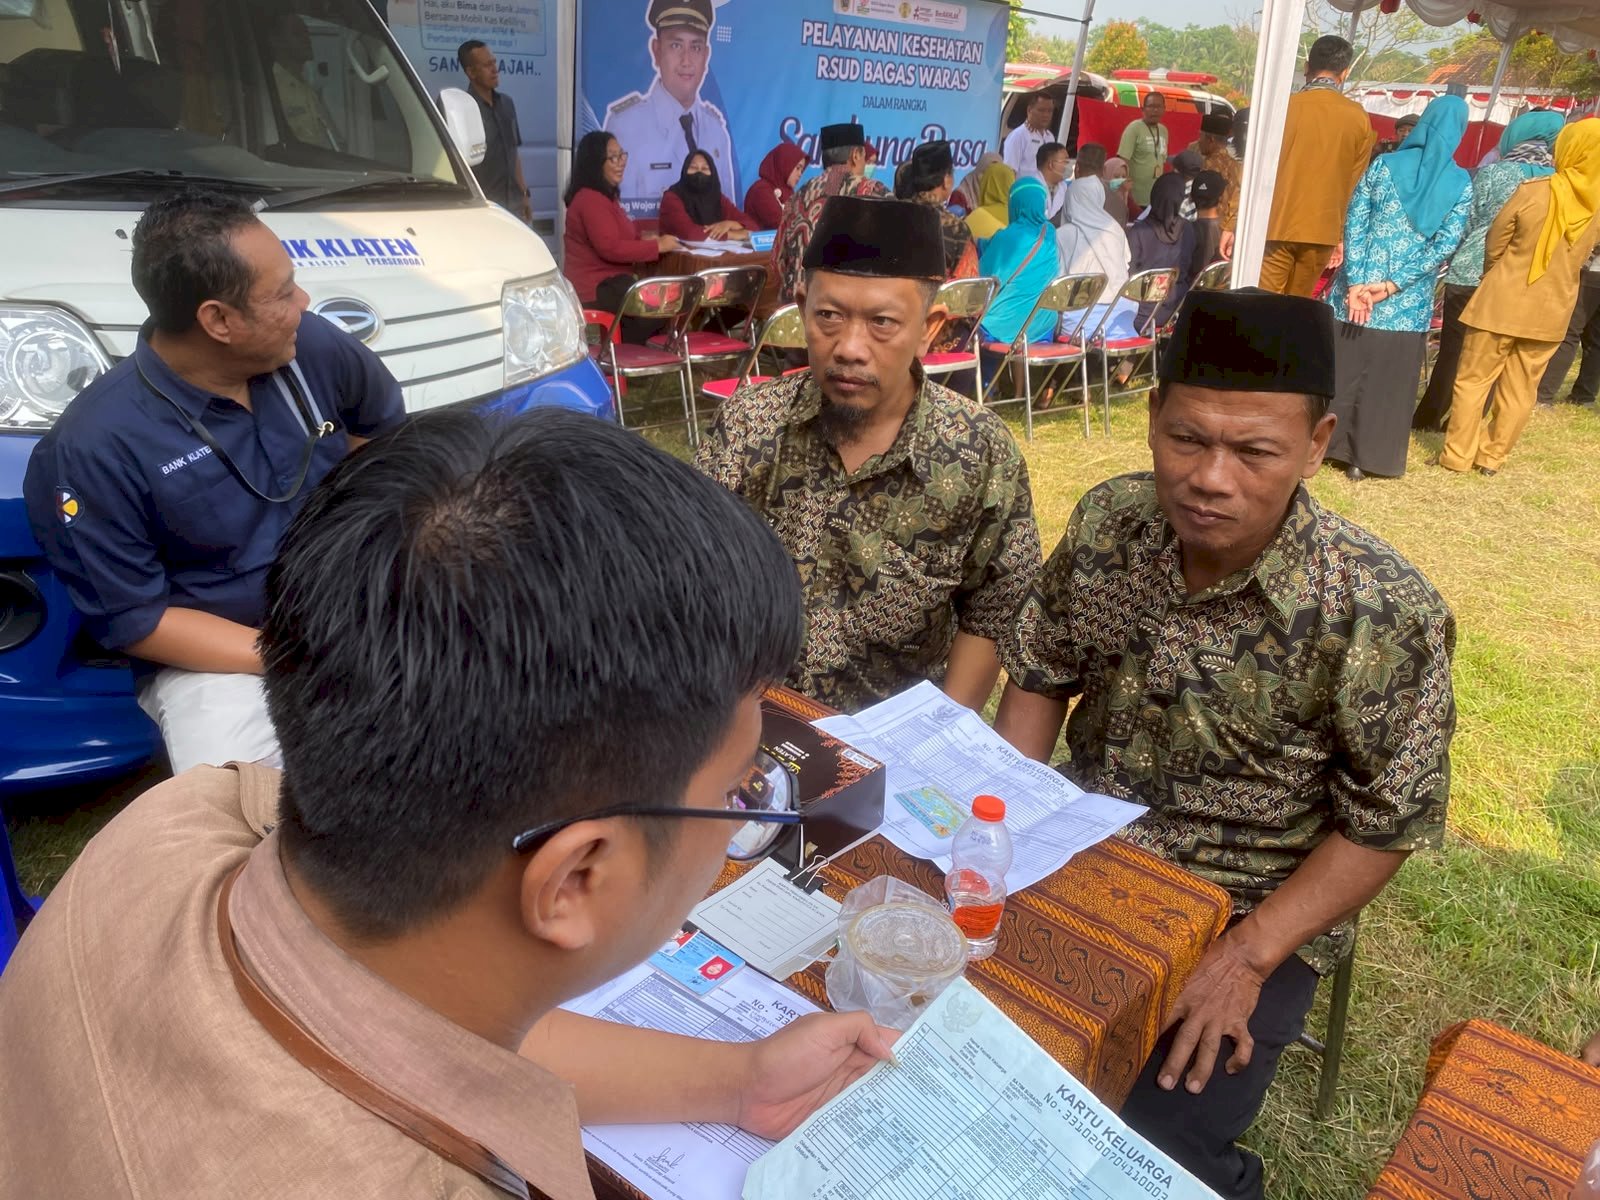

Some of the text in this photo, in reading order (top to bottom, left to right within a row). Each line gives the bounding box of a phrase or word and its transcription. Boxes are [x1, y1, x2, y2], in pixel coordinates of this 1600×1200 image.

[457, 1, 477, 10] Bima
[802, 20, 984, 64] PELAYANAN KESEHATAN
[816, 55, 971, 91] RSUD BAGAS WARAS
[862, 96, 927, 112] DALAM RANGKA
[315, 238, 419, 257] KLATEN
[162, 457, 187, 475] BANK
[996, 744, 1024, 765] KARTU
[751, 998, 770, 1013] No.
[1055, 1083, 1174, 1189] KARTU KELUARGA
